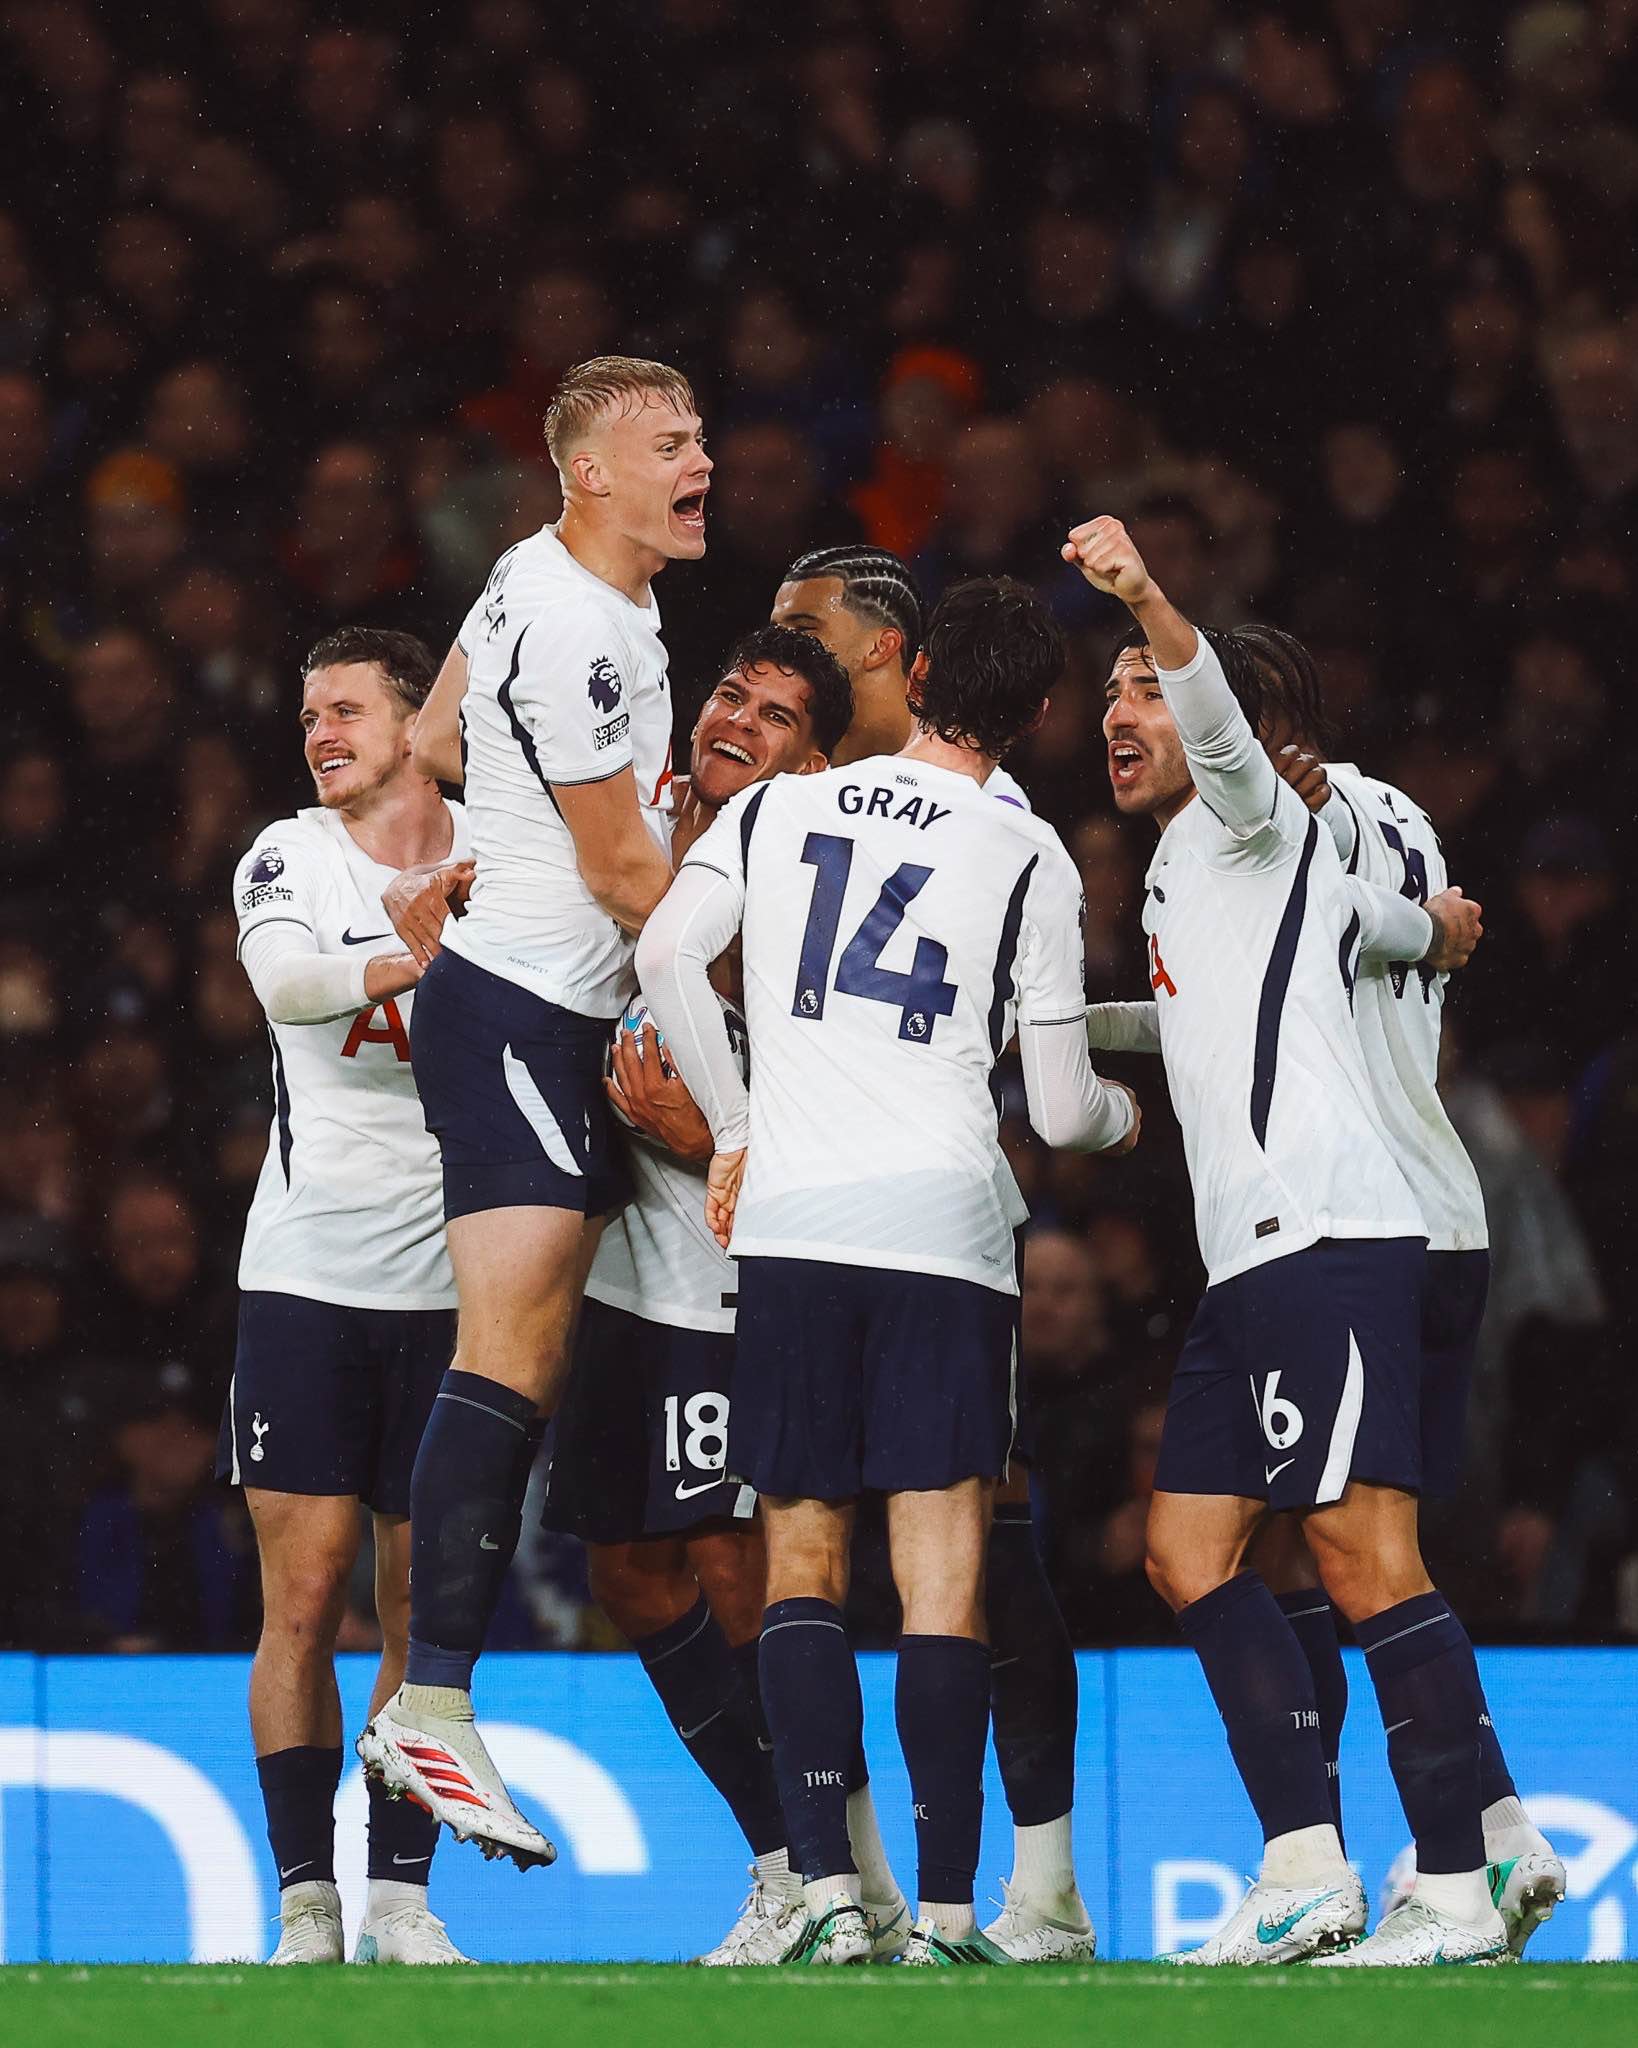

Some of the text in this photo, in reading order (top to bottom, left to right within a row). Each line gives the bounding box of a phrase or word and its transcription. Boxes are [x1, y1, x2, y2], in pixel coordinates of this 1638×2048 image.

[593, 727, 609, 740] No
[895, 774, 918, 787] 886
[838, 784, 952, 831] GRAY
[791, 832, 958, 1045] 14
[664, 1391, 731, 1472] 18
[1262, 1369, 1304, 1450] 6
[803, 1770, 845, 1787] THFC
